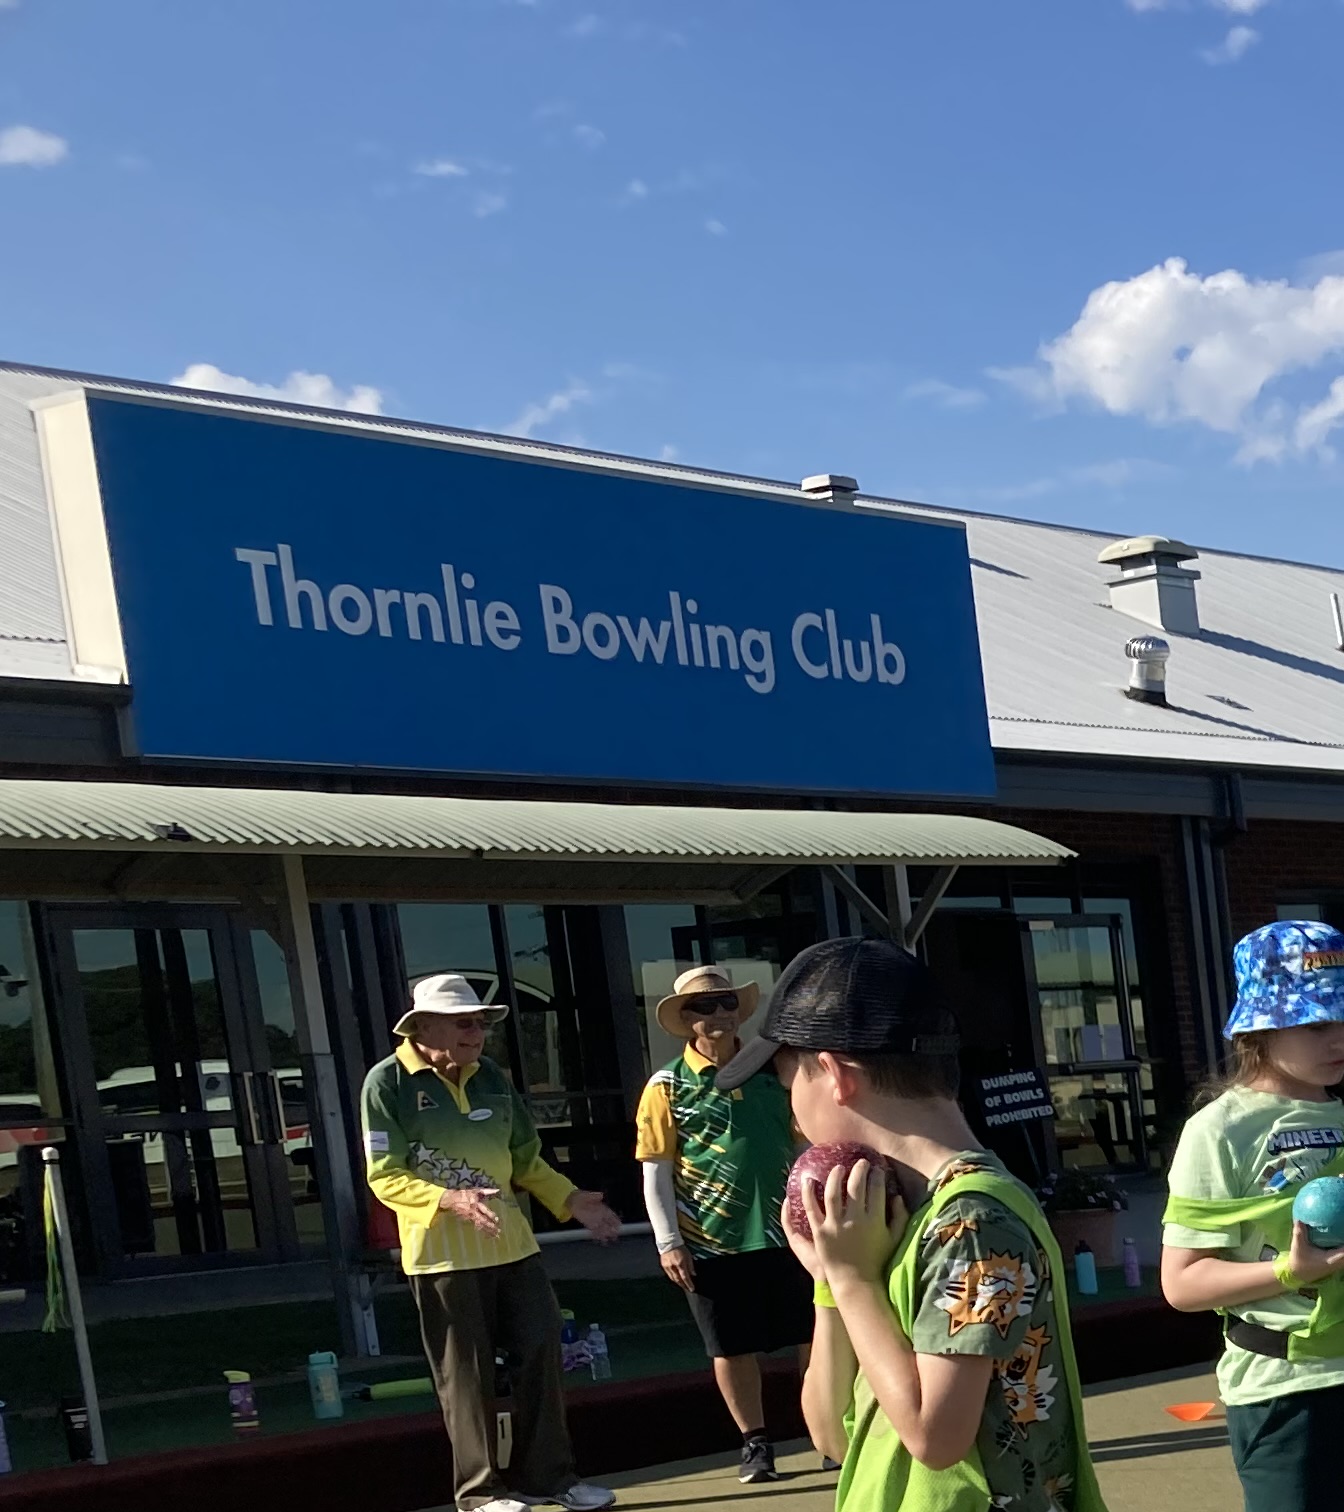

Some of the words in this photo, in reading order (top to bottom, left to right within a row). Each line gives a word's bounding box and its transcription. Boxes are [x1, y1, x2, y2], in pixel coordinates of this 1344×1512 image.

[235, 543, 522, 651] Thornlie
[539, 583, 776, 694] Bowling
[791, 608, 906, 685] Club
[981, 1071, 1036, 1090] DUMPING
[984, 1095, 1001, 1108] OF
[1003, 1087, 1045, 1105] BOWLS
[985, 1104, 1054, 1127] PROHIBITED
[499, 1417, 505, 1440] 1
